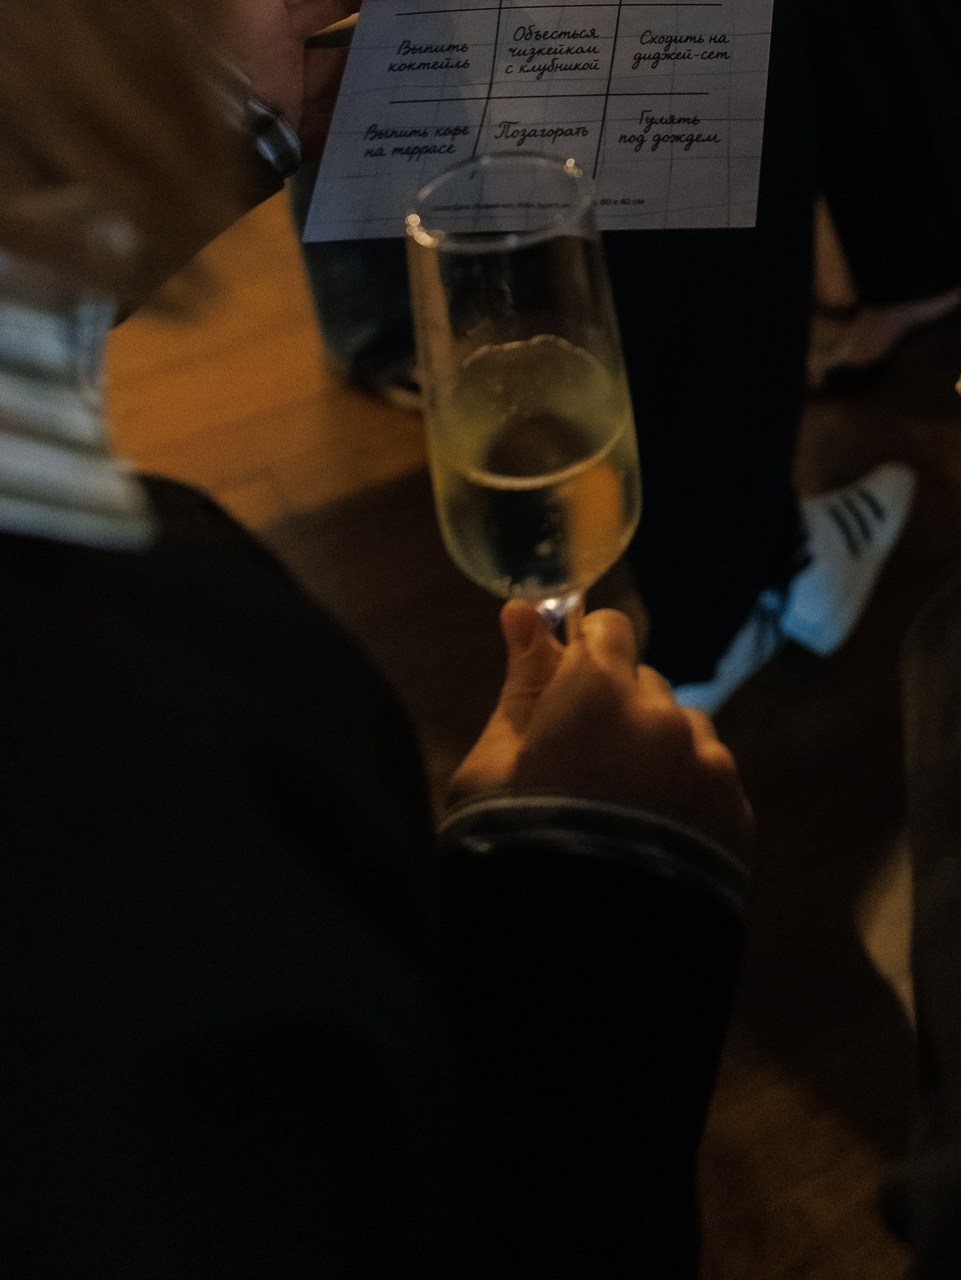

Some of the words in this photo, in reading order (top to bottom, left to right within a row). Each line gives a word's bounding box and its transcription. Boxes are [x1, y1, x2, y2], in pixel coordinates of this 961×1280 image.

[513, 24, 599, 42] Объесться
[640, 29, 704, 52] Сходить
[708, 34, 730, 44] на
[397, 39, 469, 56] Выпить
[508, 43, 600, 62] чизкейком
[387, 57, 470, 72] коктейль
[505, 64, 513, 74] с
[519, 58, 600, 80] клубникой
[631, 49, 731, 70] диджей-сет
[639, 109, 700, 133] Гулять
[434, 125, 470, 143] кофе
[494, 120, 589, 147] Позагорать
[618, 133, 646, 152] под
[651, 133, 722, 152] дождем
[364, 145, 385, 158] на
